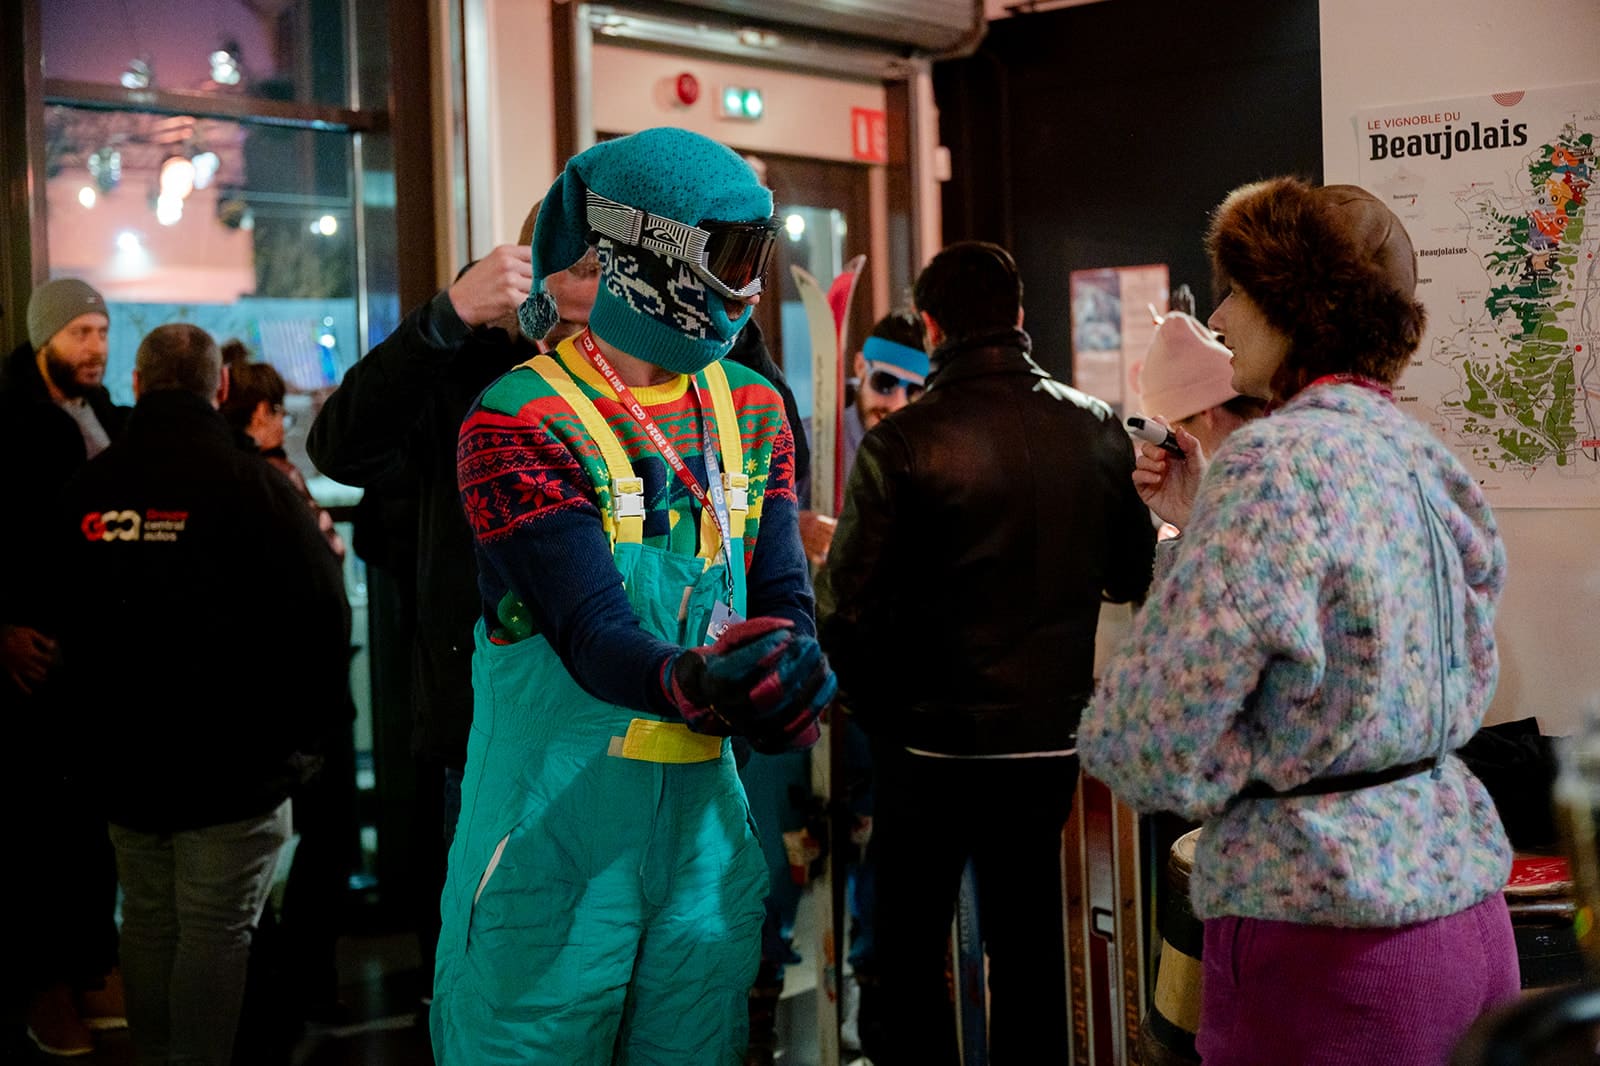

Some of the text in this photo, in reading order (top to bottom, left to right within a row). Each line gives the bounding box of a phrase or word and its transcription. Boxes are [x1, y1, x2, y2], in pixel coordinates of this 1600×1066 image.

[1367, 112, 1461, 130] LE VIGNOBLE DU
[1369, 119, 1528, 160] Beaujolais
[1420, 247, 1468, 257] Beaujolaises
[593, 353, 626, 393] SKI PASS
[645, 422, 684, 472] NOEL 2024
